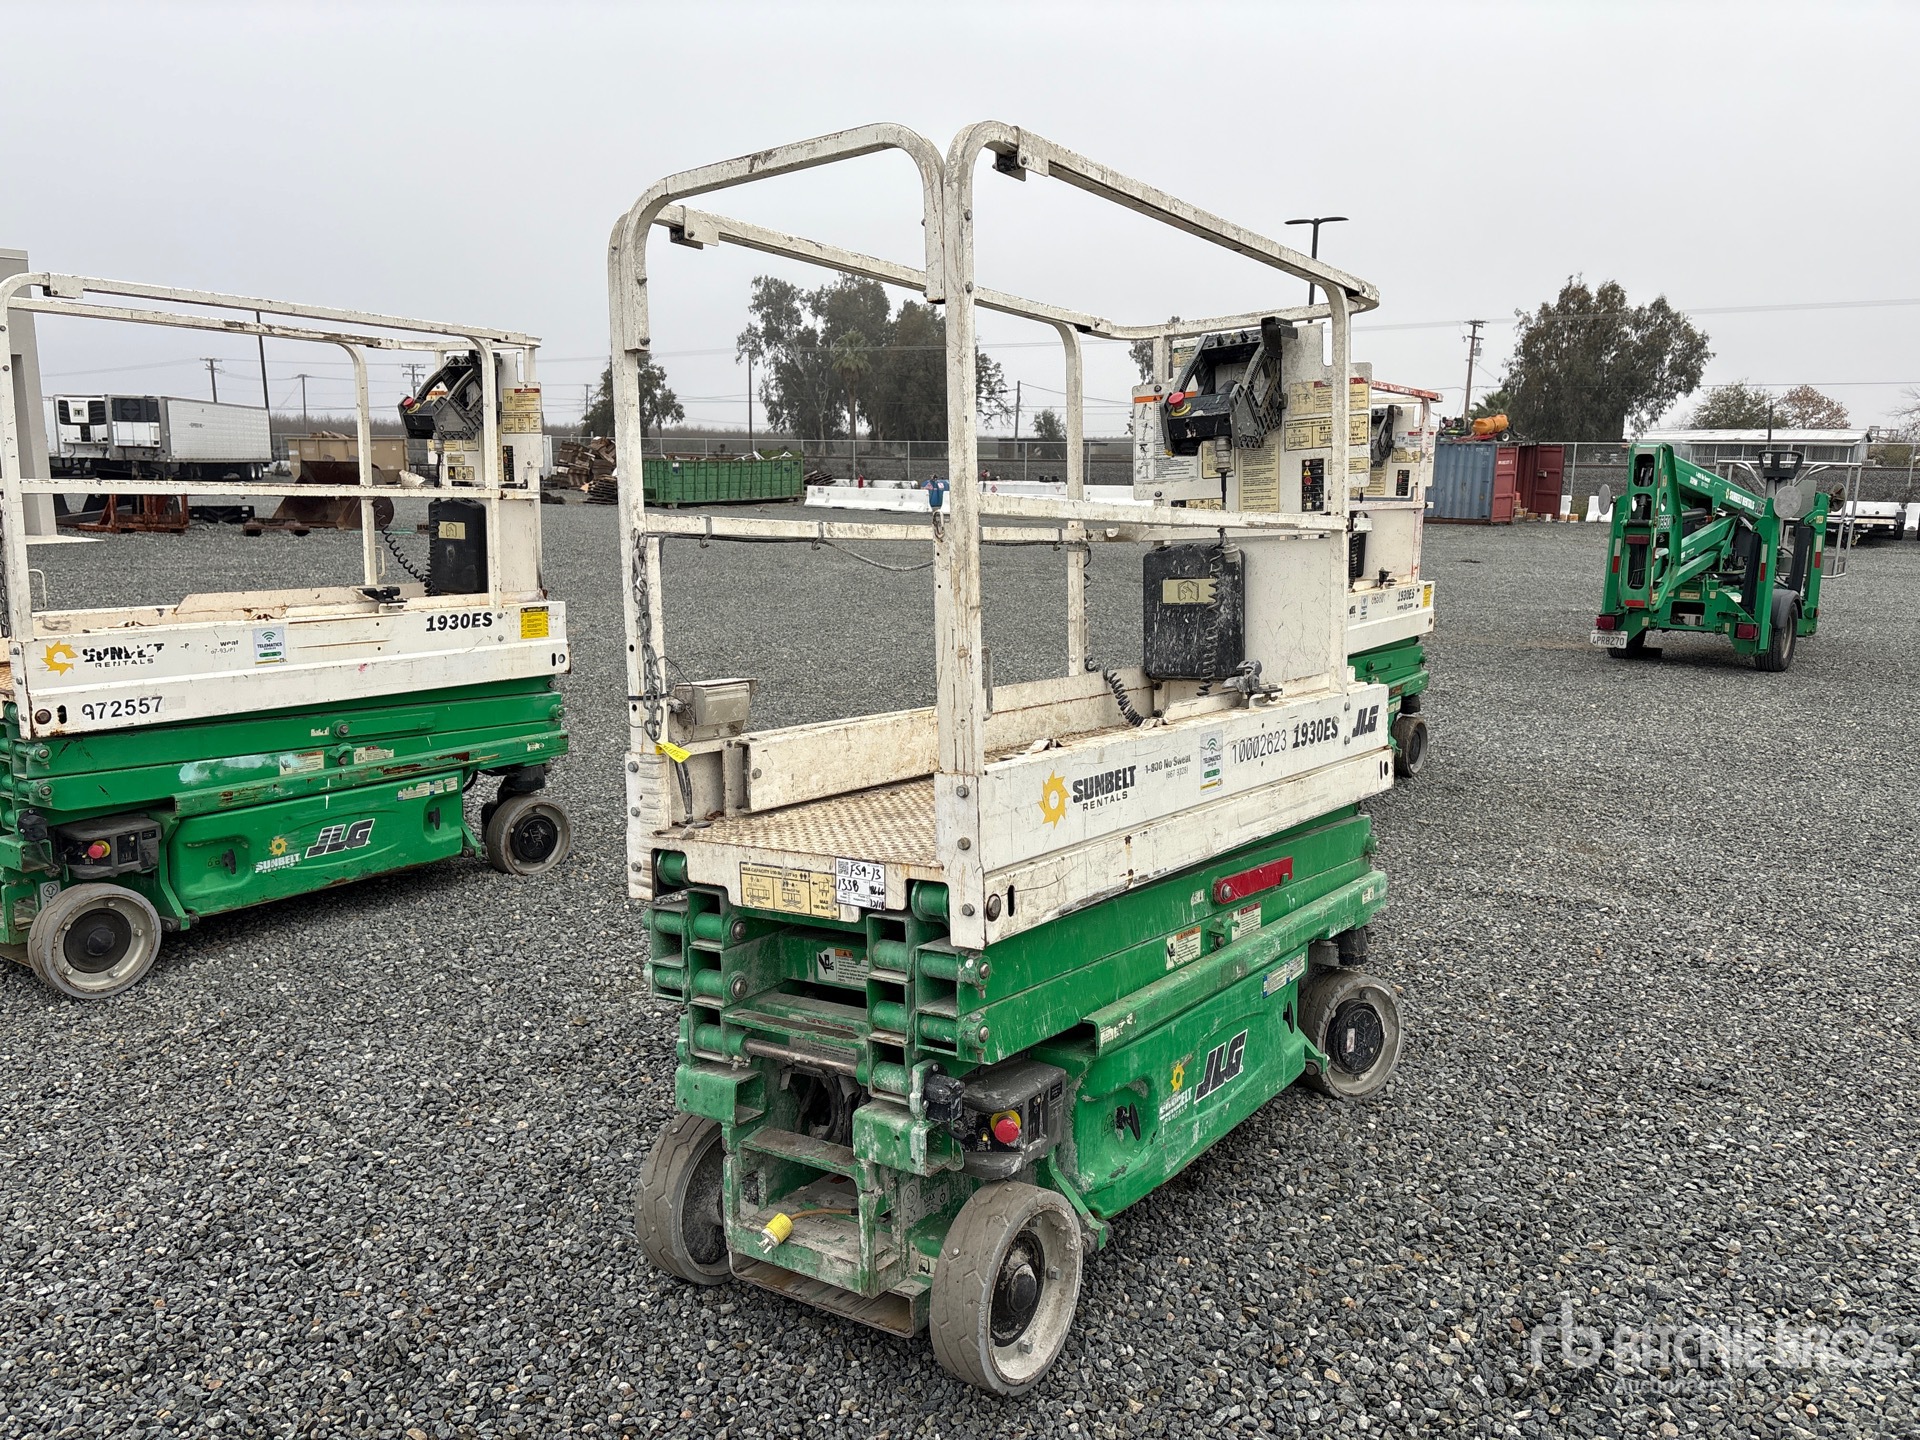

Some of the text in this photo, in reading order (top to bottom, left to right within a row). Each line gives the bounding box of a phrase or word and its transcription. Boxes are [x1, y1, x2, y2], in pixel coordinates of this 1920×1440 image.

[426, 612, 493, 632] 1930ES
[1592, 636, 1625, 646] 4PR8270
[82, 696, 163, 720] 972557
[1232, 705, 1379, 765] 10002623 1930ES JLG
[1072, 765, 1137, 804] SUNBELT
[1082, 791, 1128, 812] RENTALS
[304, 818, 375, 859] JLG
[255, 853, 301, 873] SUNBELT
[1194, 1029, 1248, 1104] JLG
